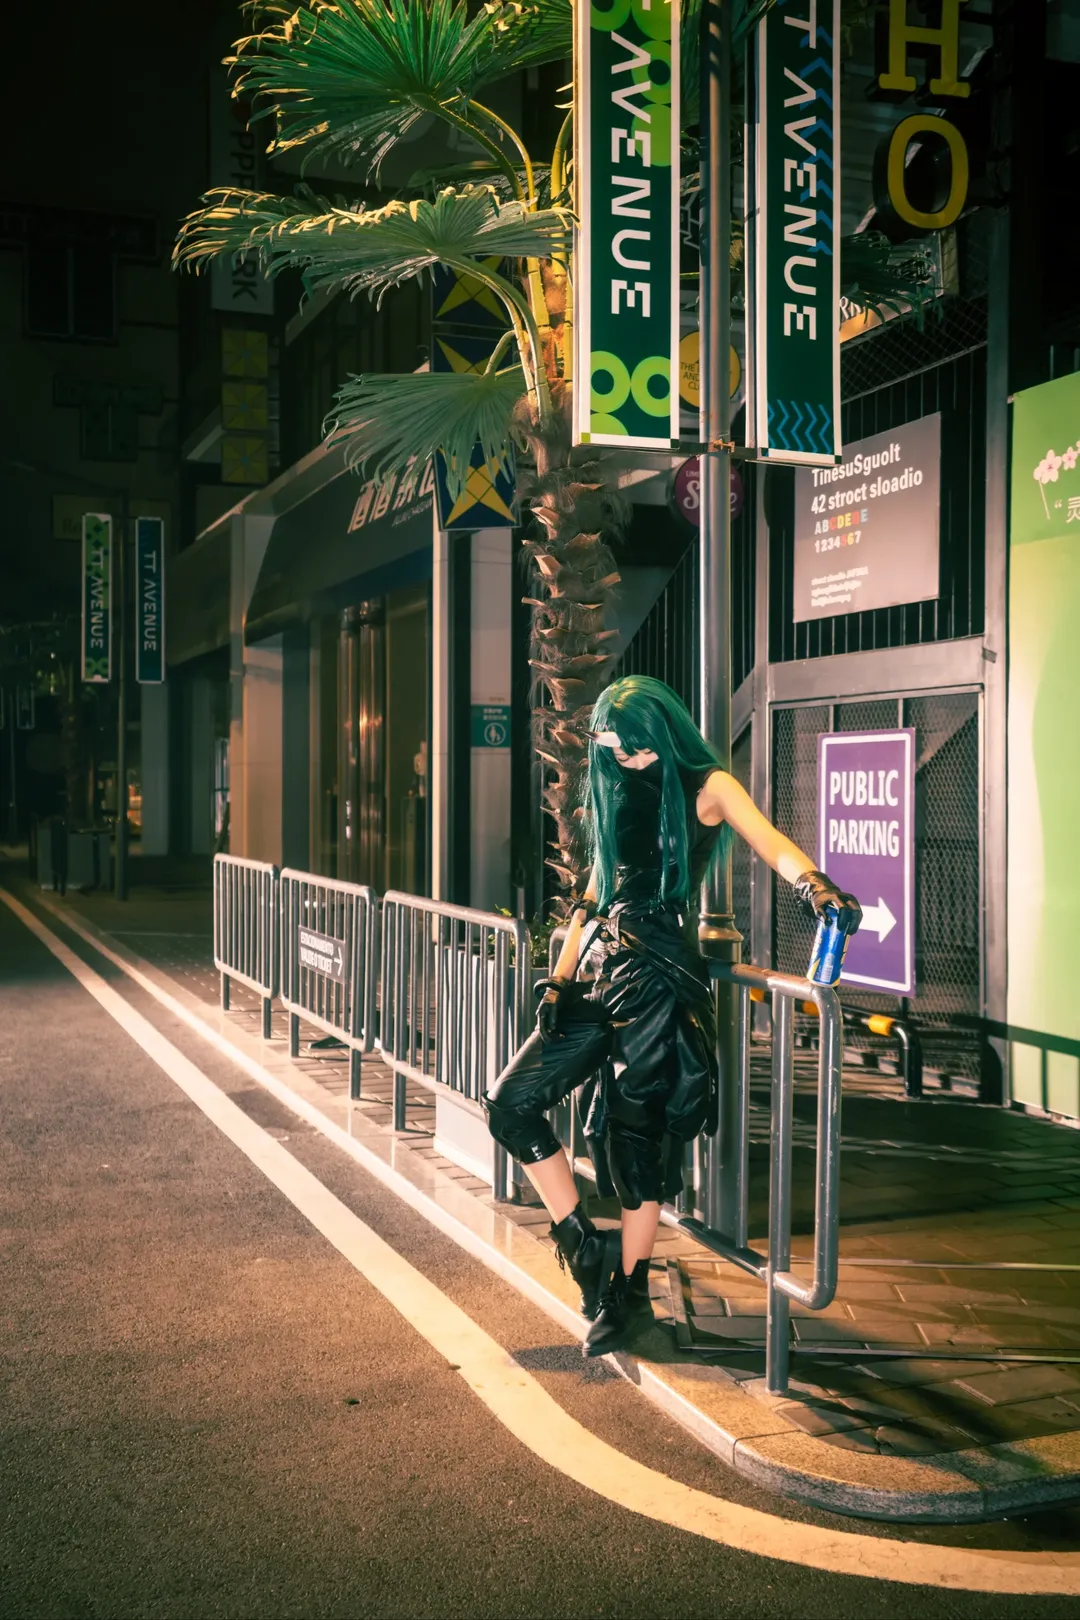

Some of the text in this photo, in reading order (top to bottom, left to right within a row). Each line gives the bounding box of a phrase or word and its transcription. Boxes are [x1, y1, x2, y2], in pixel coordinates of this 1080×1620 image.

[611, 31, 651, 318] AVENUE
[784, 66, 817, 340] AVENUE
[811, 494, 827, 514] 42
[91, 576, 104, 649] AVENUE
[144, 579, 156, 651] AVENUE
[829, 769, 899, 807] PUBLIC
[829, 819, 900, 858] PARKING
